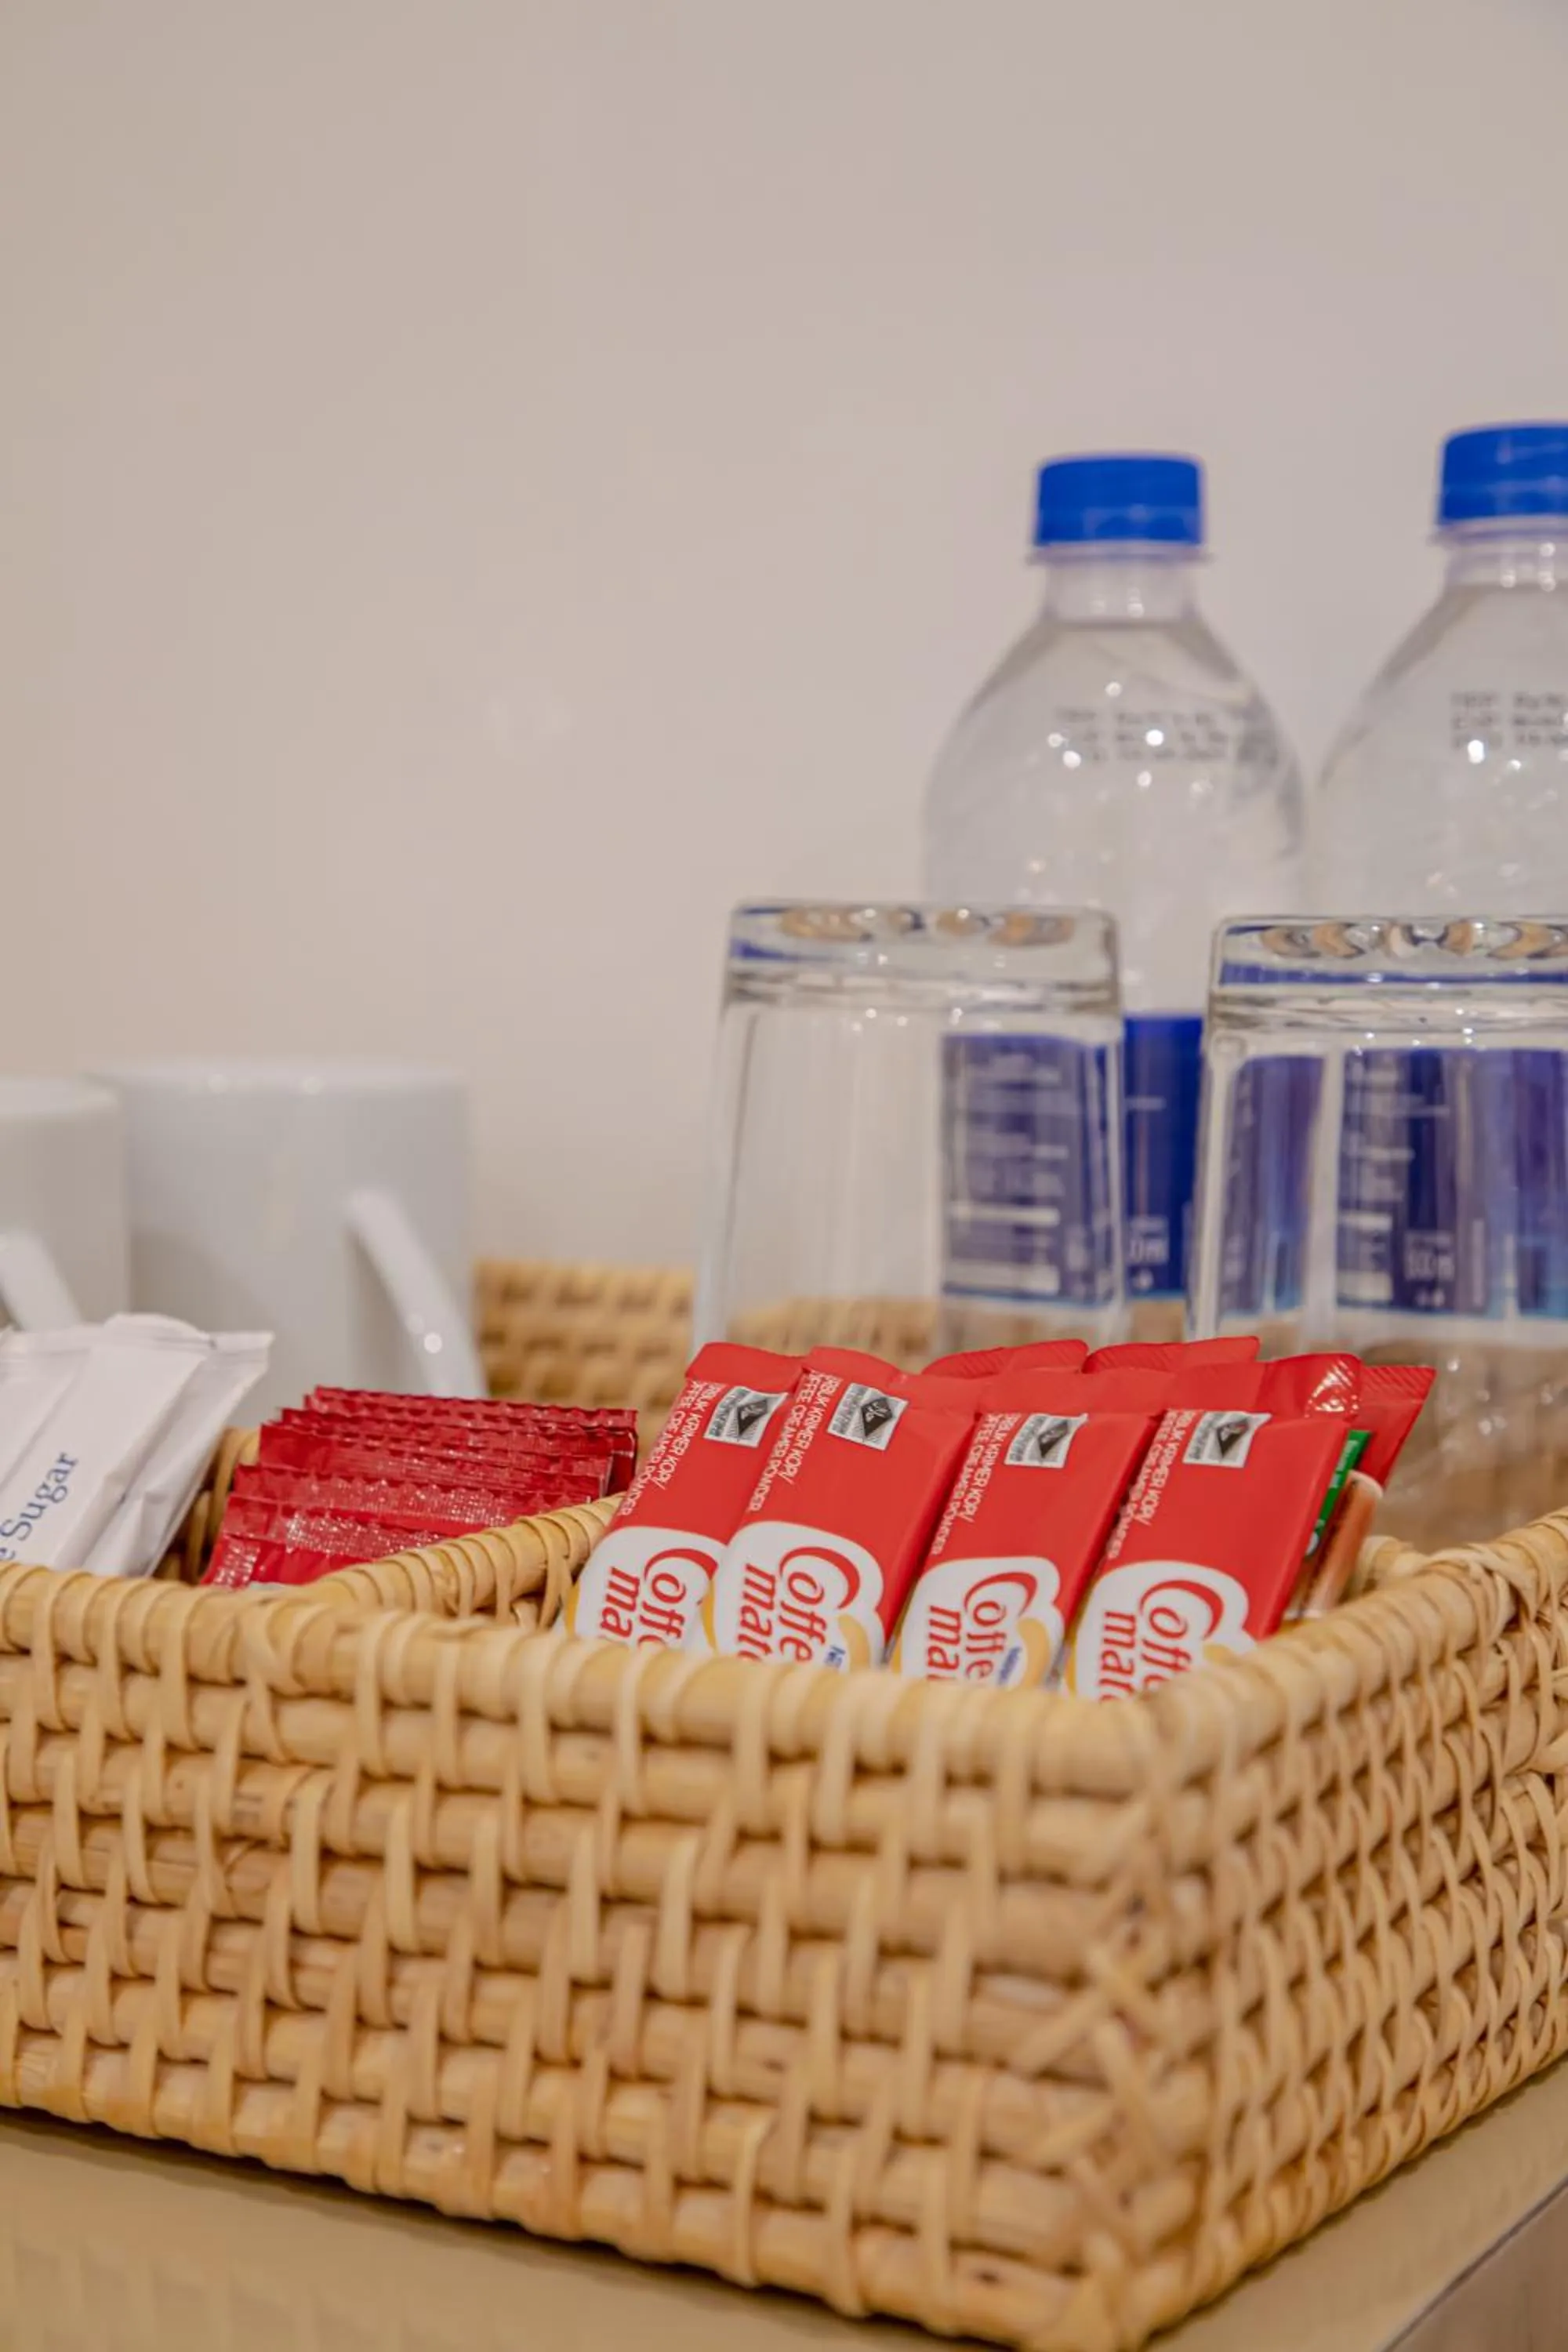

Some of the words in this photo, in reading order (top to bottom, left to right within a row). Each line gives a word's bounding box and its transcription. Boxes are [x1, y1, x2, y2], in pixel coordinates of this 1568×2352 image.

[650, 1410, 686, 1464] CREAMER
[669, 1413, 703, 1456] KRIMER
[771, 1403, 807, 1458] CREAMER
[793, 1406, 826, 1450] KRIMER
[618, 1463, 655, 1516] POWDER
[650, 1455, 679, 1490] KOPI/
[747, 1459, 782, 1512] POWDER
[777, 1448, 806, 1485] KOPI/
[973, 1443, 1002, 1488] KRIMER
[0, 1452, 78, 1541] Sugar
[599, 1566, 640, 1639] ma
[1099, 1611, 1135, 1704] mat
